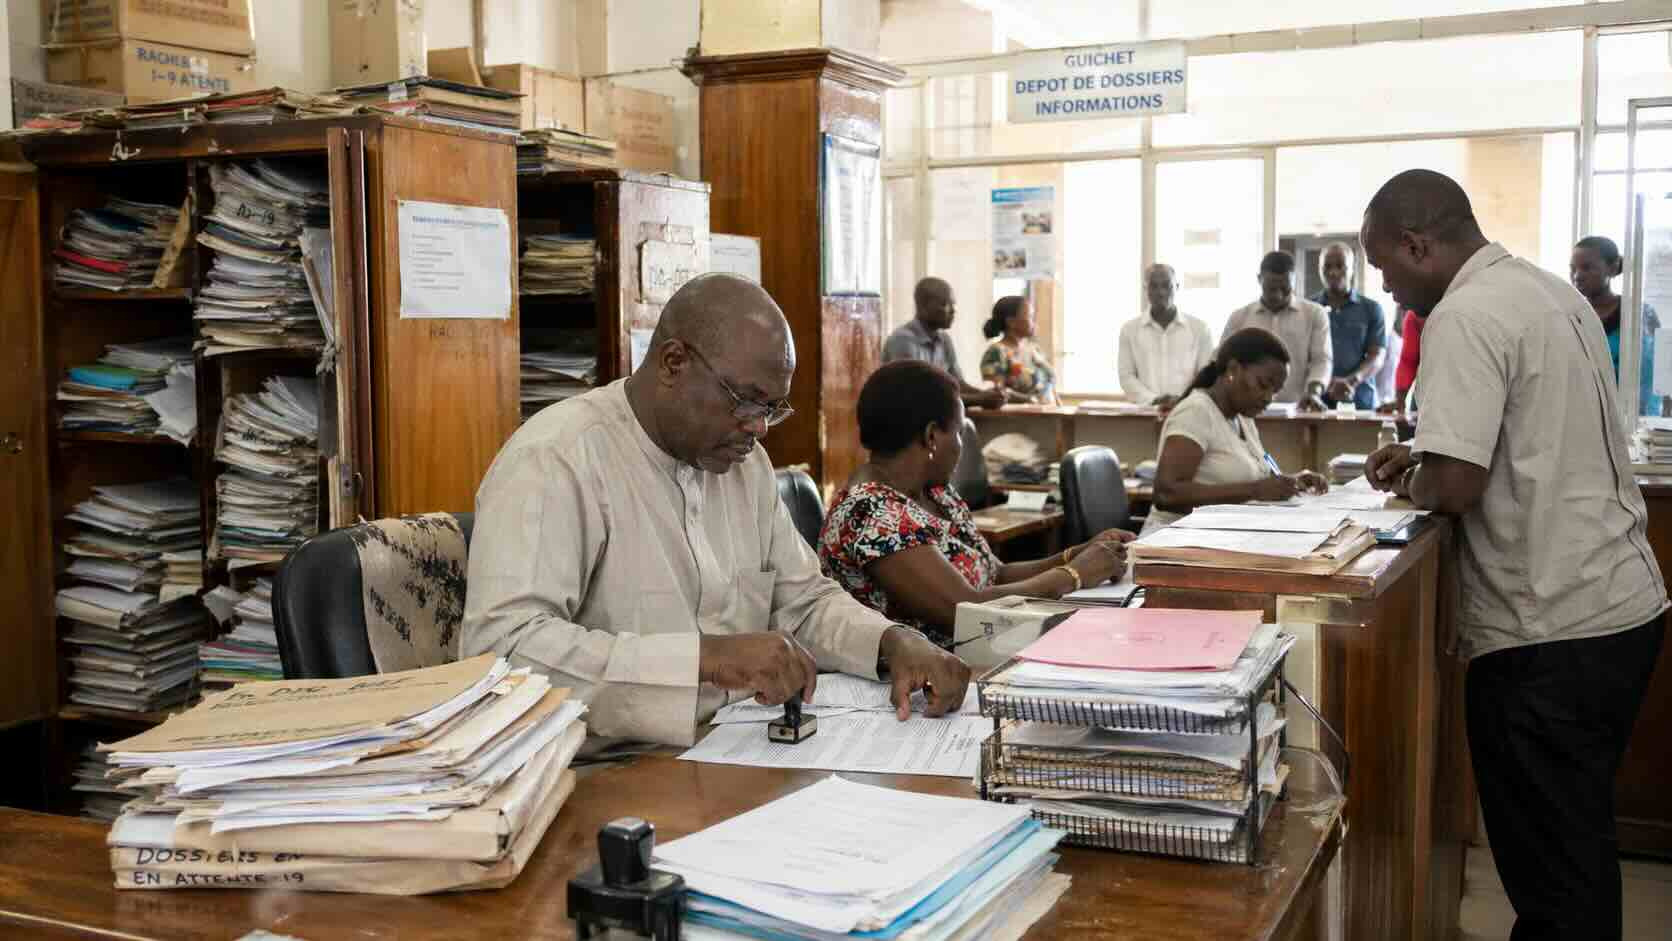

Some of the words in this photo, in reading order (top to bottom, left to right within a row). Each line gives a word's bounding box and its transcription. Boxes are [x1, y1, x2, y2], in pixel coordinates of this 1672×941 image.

[1064, 50, 1135, 67] GUICHET
[1015, 77, 1067, 94] DEPOT
[1073, 75, 1095, 91] DE
[1101, 70, 1184, 89] DOSSIERS
[1035, 94, 1163, 116] INFORMATIONS
[133, 870, 160, 885] EN
